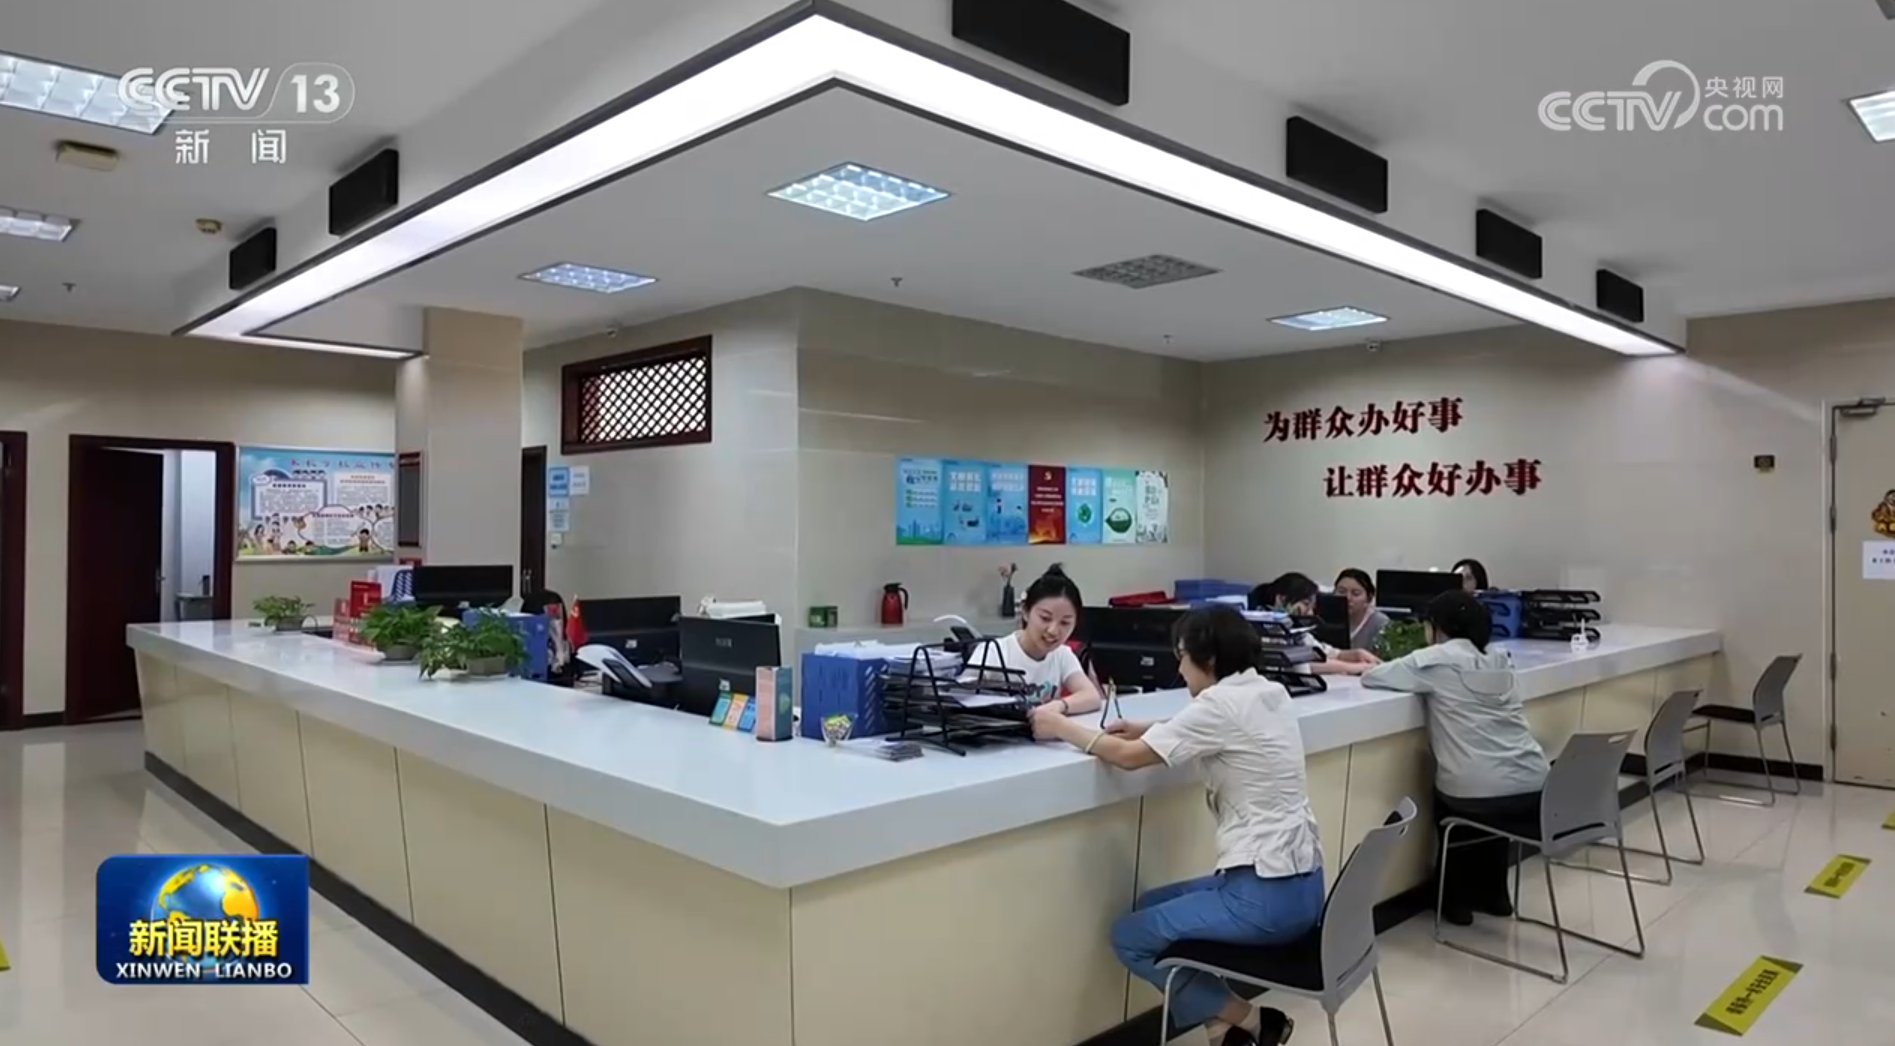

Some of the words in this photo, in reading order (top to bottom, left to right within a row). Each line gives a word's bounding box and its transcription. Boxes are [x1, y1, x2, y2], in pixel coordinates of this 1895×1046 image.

[1263, 397, 1464, 442] 为群众办好事
[1323, 458, 1542, 499] 让群众好办事
